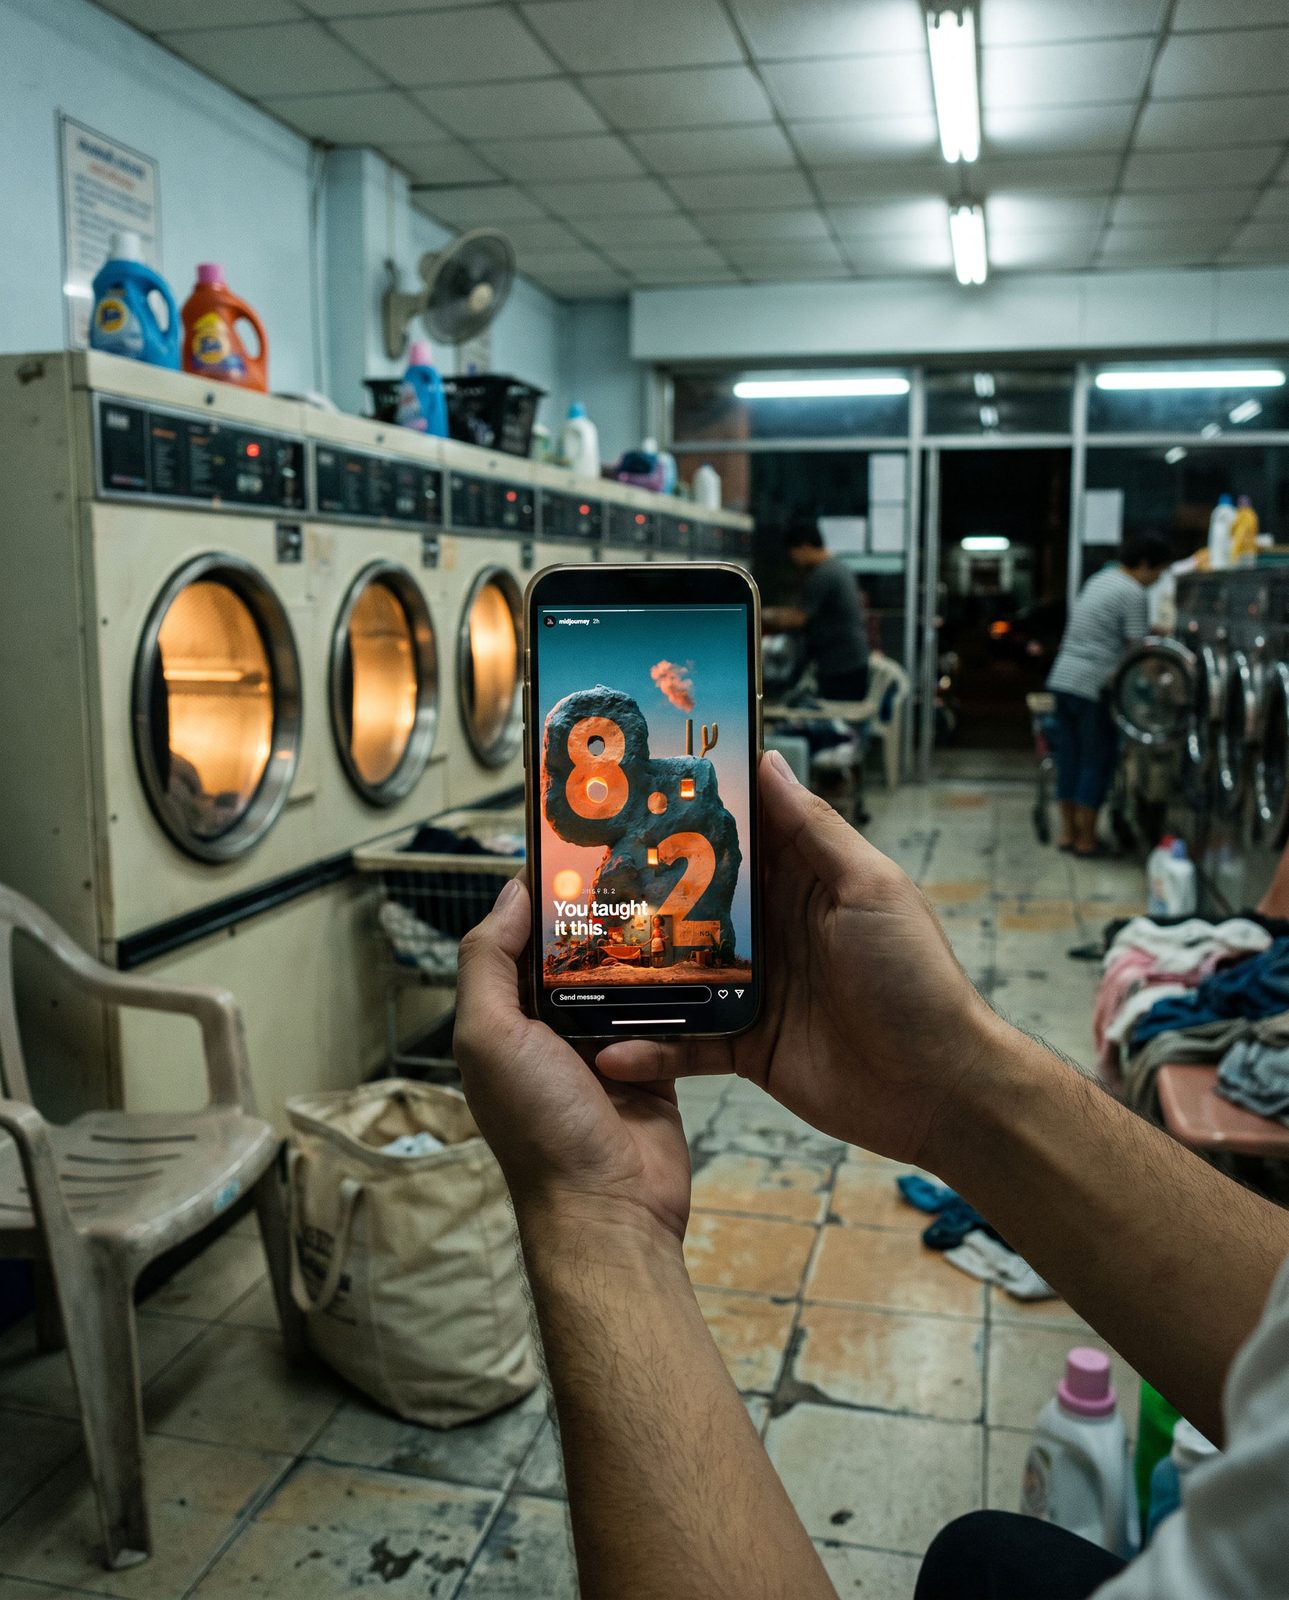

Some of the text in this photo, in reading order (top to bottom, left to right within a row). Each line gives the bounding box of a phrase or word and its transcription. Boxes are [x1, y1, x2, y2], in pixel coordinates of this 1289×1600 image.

[559, 618, 590, 626] midjourney
[553, 900, 648, 920] You taught
[555, 919, 608, 936] it this.
[559, 993, 605, 1002] Send message
